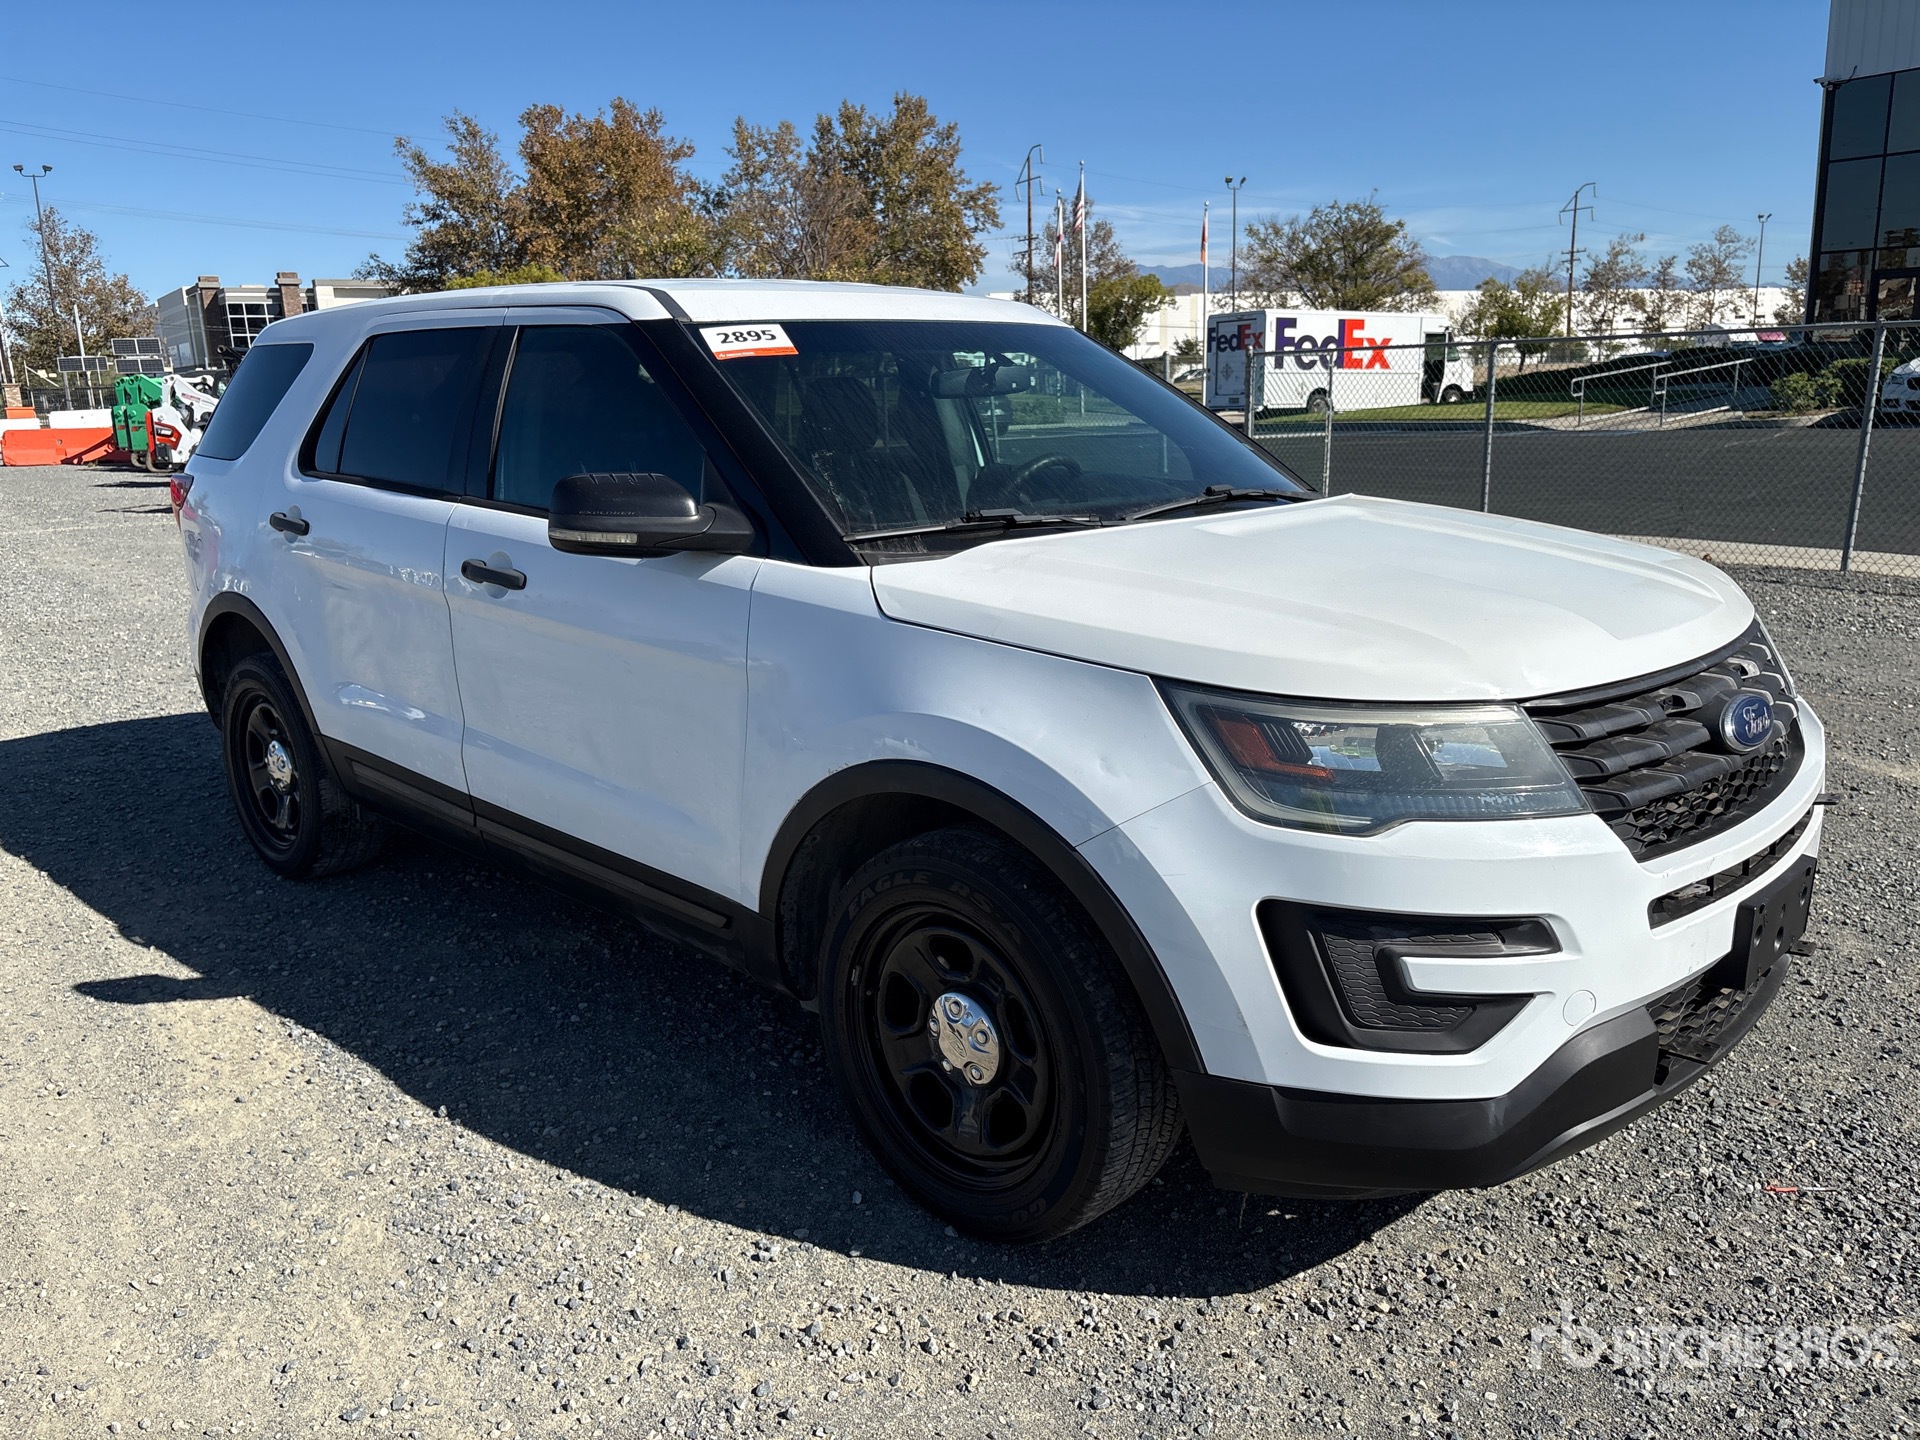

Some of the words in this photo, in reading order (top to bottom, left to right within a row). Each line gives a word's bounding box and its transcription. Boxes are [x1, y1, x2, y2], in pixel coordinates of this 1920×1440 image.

[716, 329, 777, 344] 2895
[1207, 323, 1264, 353] FedEx
[1274, 317, 1392, 370] FedEx
[1743, 703, 1771, 739] Ford
[847, 870, 932, 921] EAGLE
